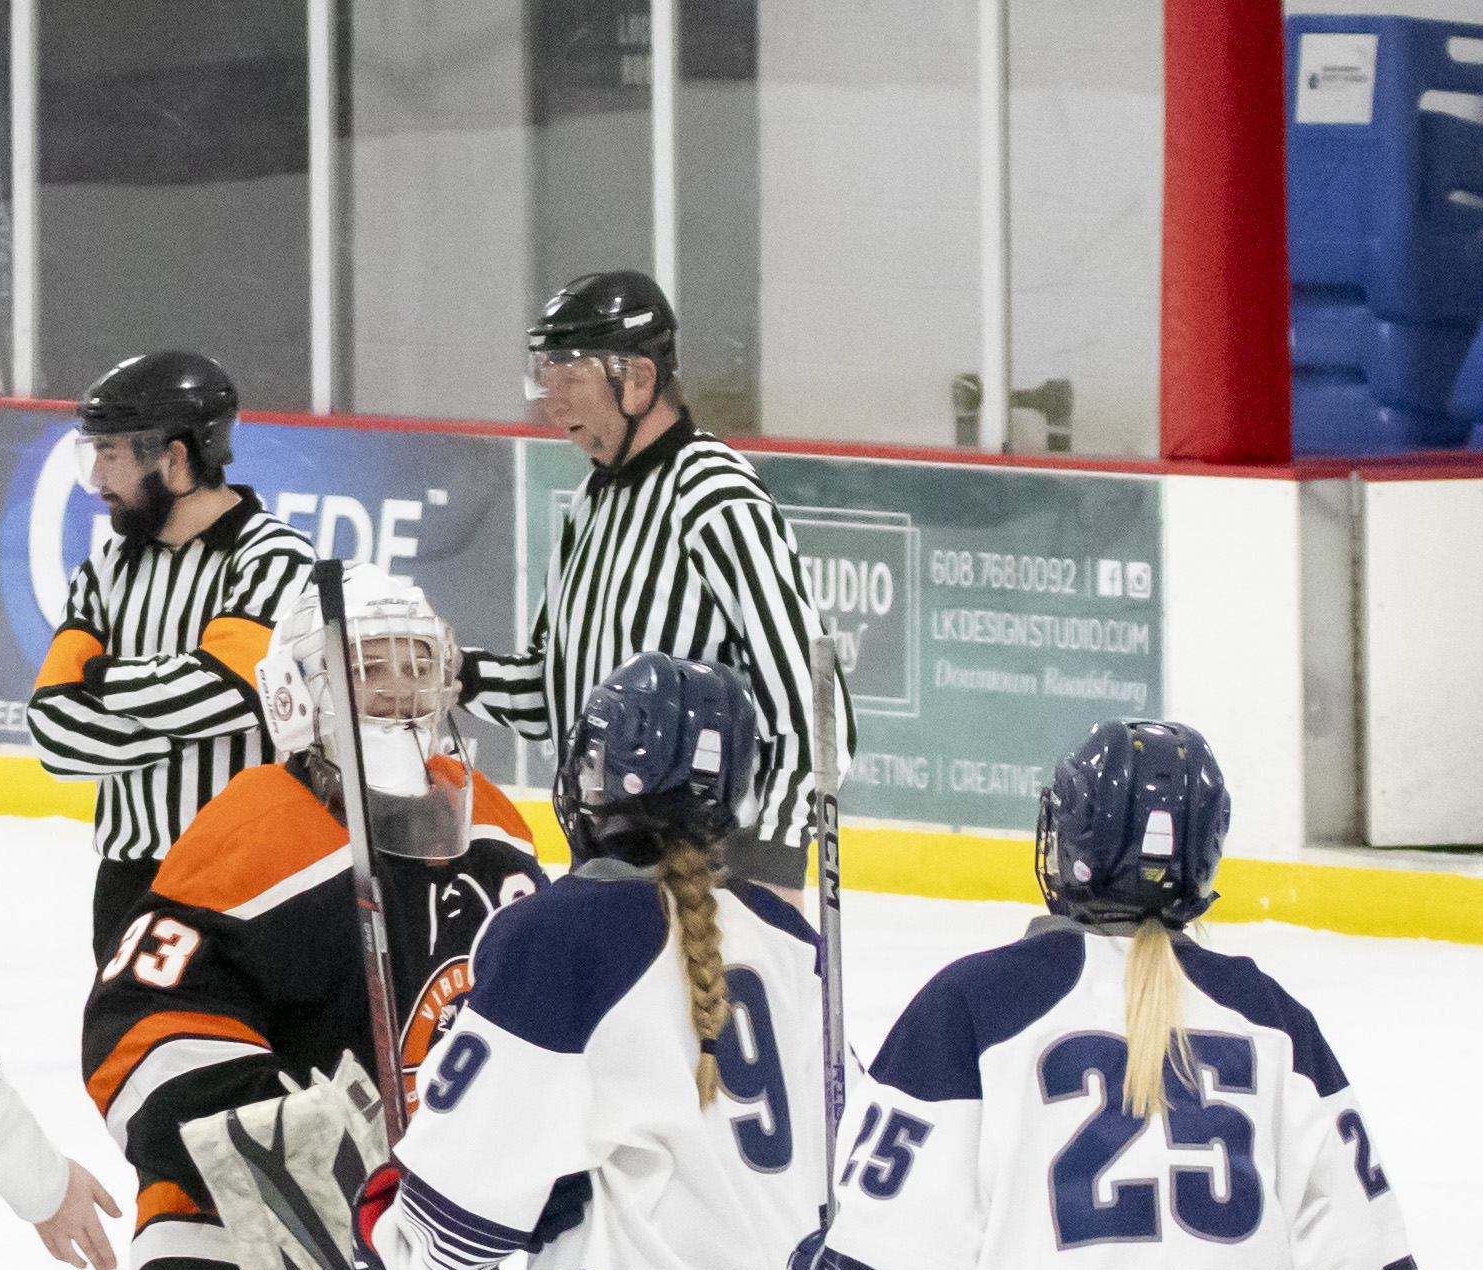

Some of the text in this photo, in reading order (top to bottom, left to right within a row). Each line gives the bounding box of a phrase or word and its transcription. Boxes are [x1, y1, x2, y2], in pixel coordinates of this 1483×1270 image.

[275, 492, 424, 586] EDE
[799, 556, 894, 616] UDIO
[824, 794, 840, 912] CCM
[424, 1031, 491, 1115] 9
[712, 963, 794, 1175] 9
[838, 1102, 935, 1201] 25
[1036, 1029, 1265, 1252] 25
